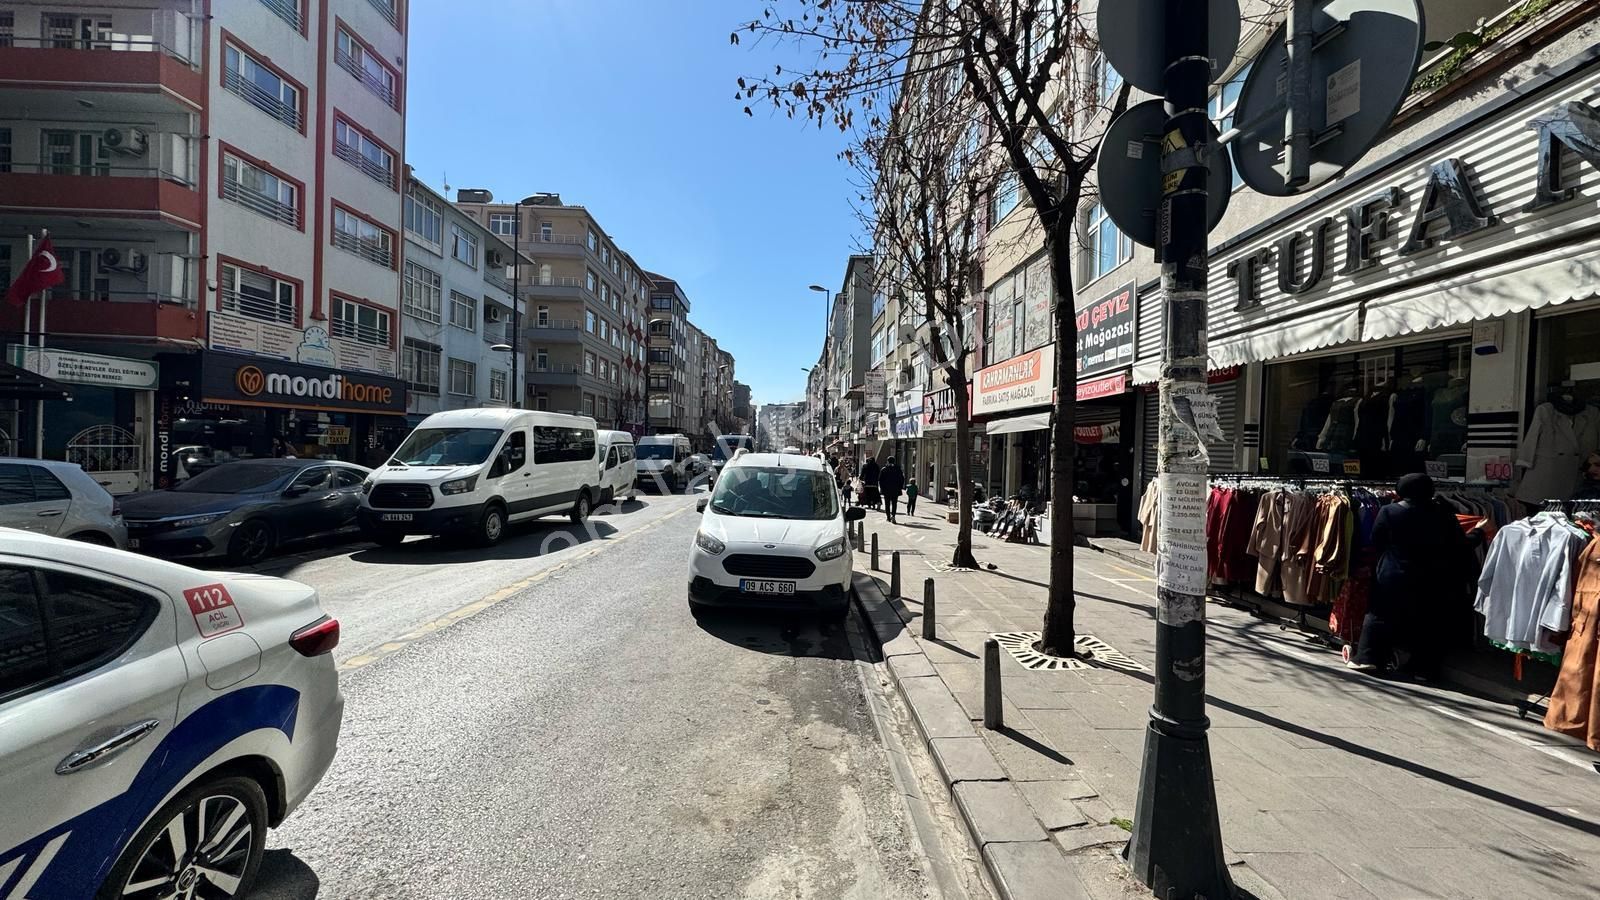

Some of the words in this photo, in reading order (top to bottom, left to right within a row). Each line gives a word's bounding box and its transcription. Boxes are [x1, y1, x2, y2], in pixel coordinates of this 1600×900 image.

[1085, 320, 1133, 349] Mağazası
[267, 373, 392, 404] mondihome
[745, 581, 756, 591] 09
[759, 582, 775, 592] ACS
[778, 583, 794, 593] 660
[193, 588, 227, 610] 112
[208, 610, 228, 623] ACİL
